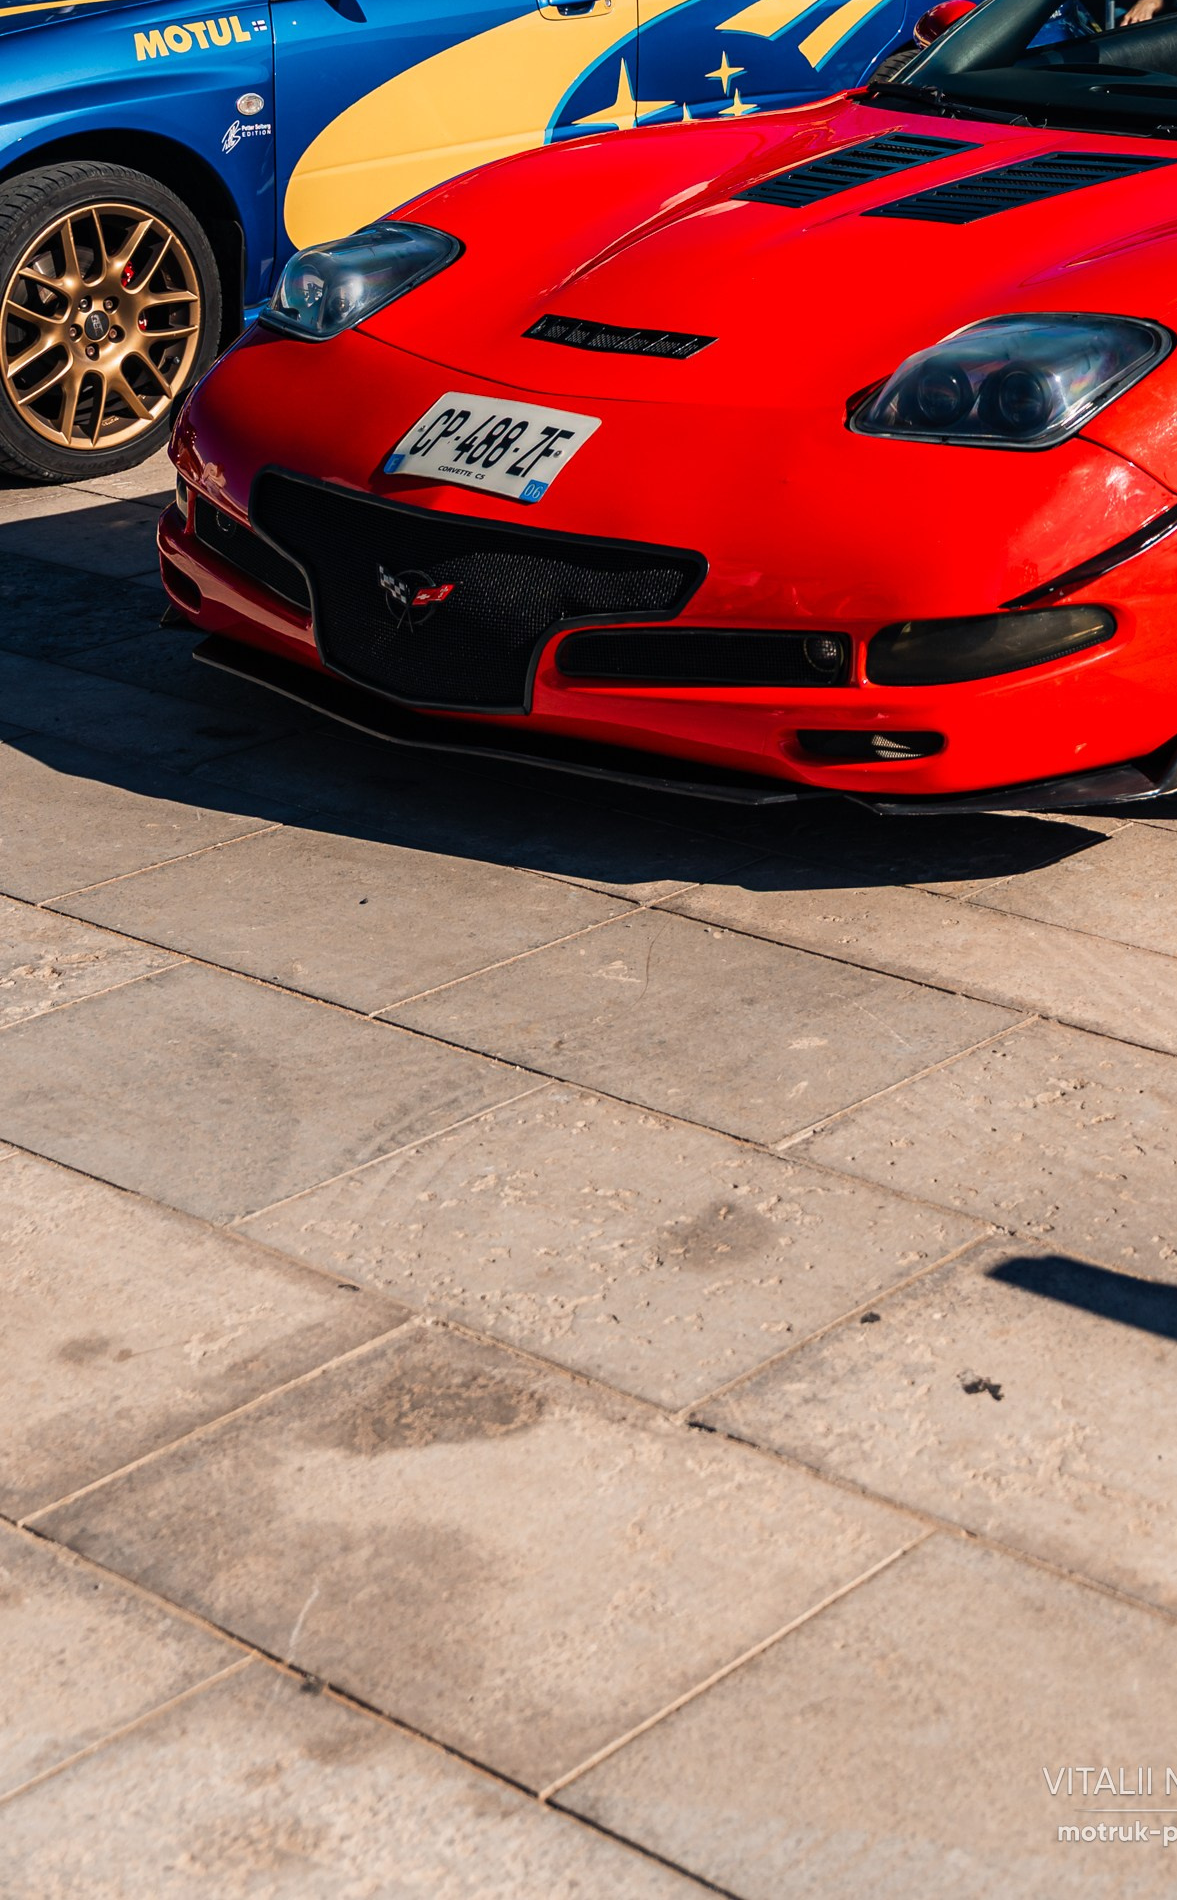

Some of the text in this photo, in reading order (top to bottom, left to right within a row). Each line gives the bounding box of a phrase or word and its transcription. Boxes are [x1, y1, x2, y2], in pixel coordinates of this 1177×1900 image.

[134, 15, 251, 61] MOTUL
[242, 129, 271, 137] EDITION
[391, 458, 400, 469] F
[438, 465, 485, 480] CORVETTE C5
[524, 484, 542, 498] 06
